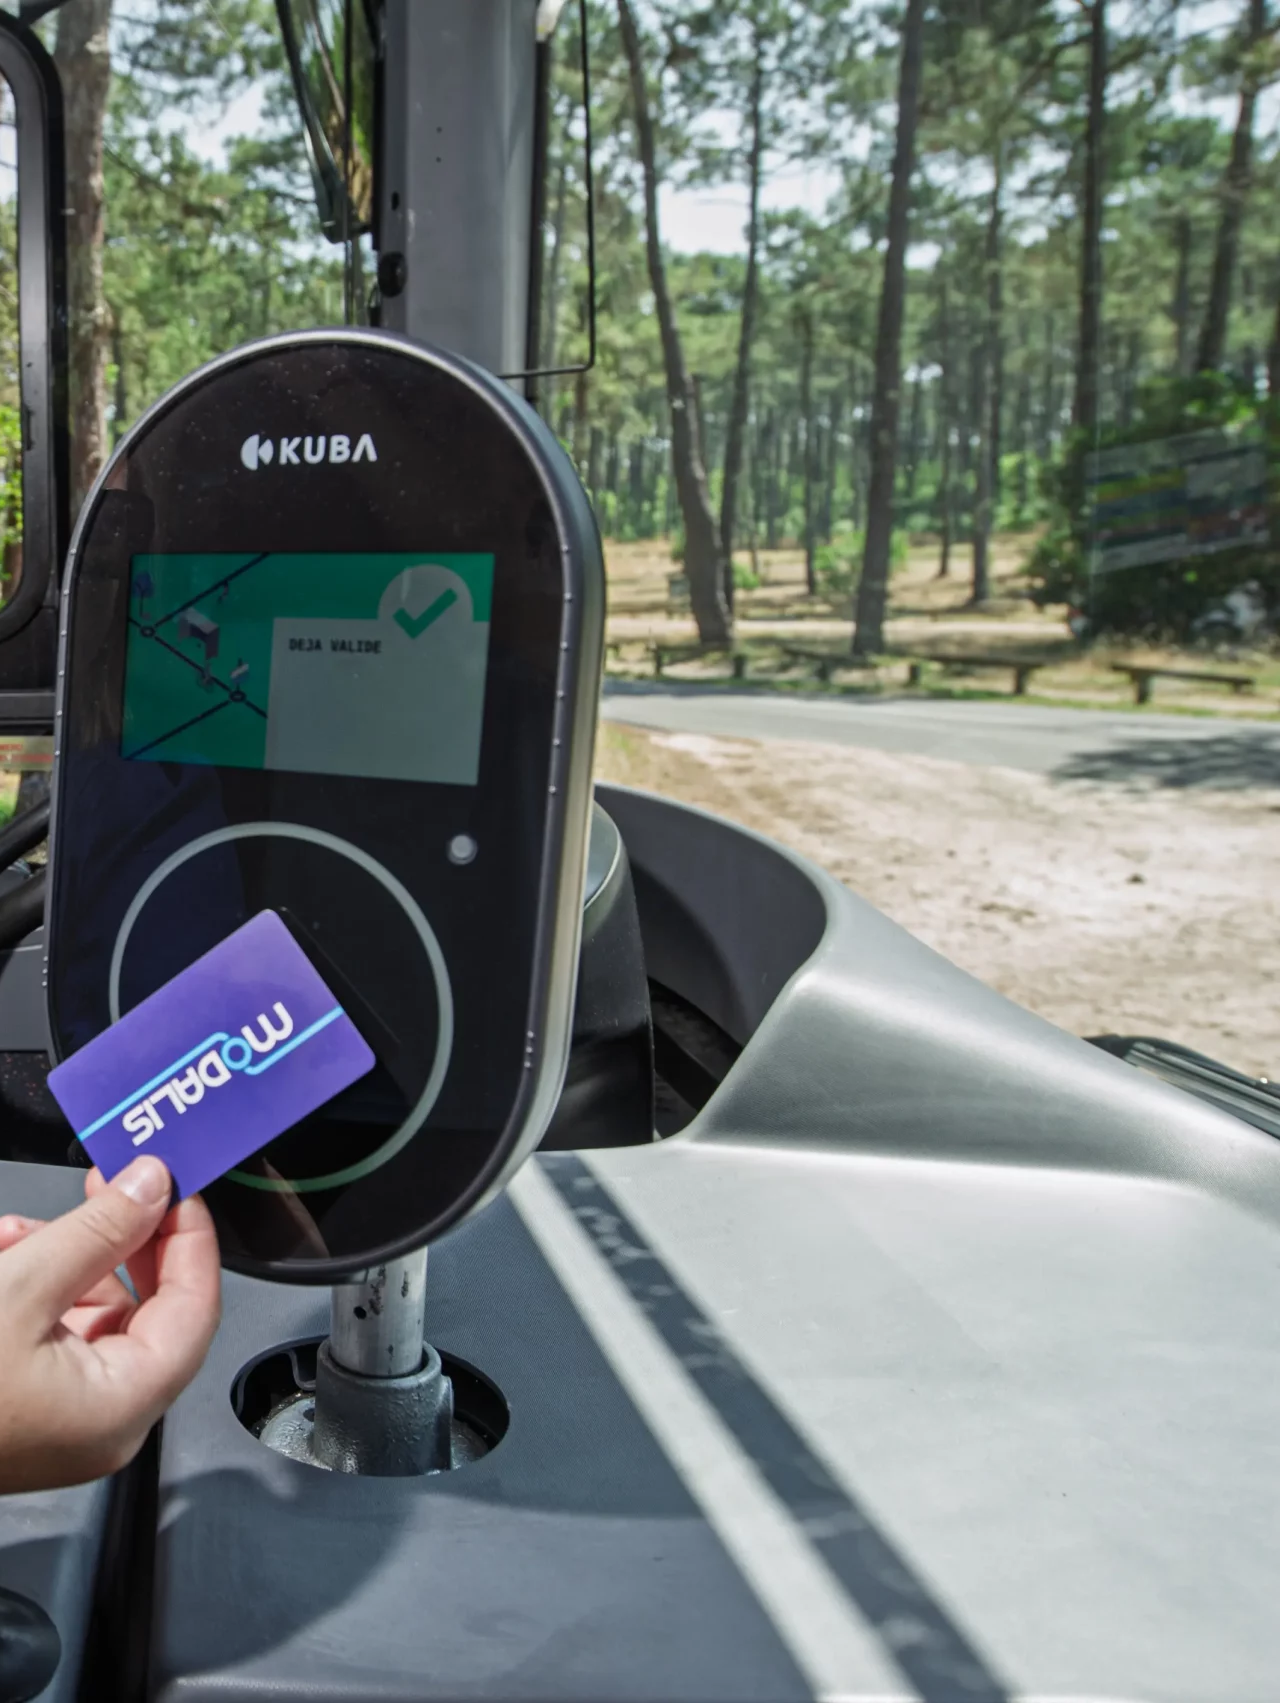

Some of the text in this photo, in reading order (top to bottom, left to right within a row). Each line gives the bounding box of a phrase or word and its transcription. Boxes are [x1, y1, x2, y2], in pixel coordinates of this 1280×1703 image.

[278, 433, 378, 466] KUBA
[288, 638, 382, 655] DEJA VALIDE
[122, 1001, 294, 1147] MODALIS
